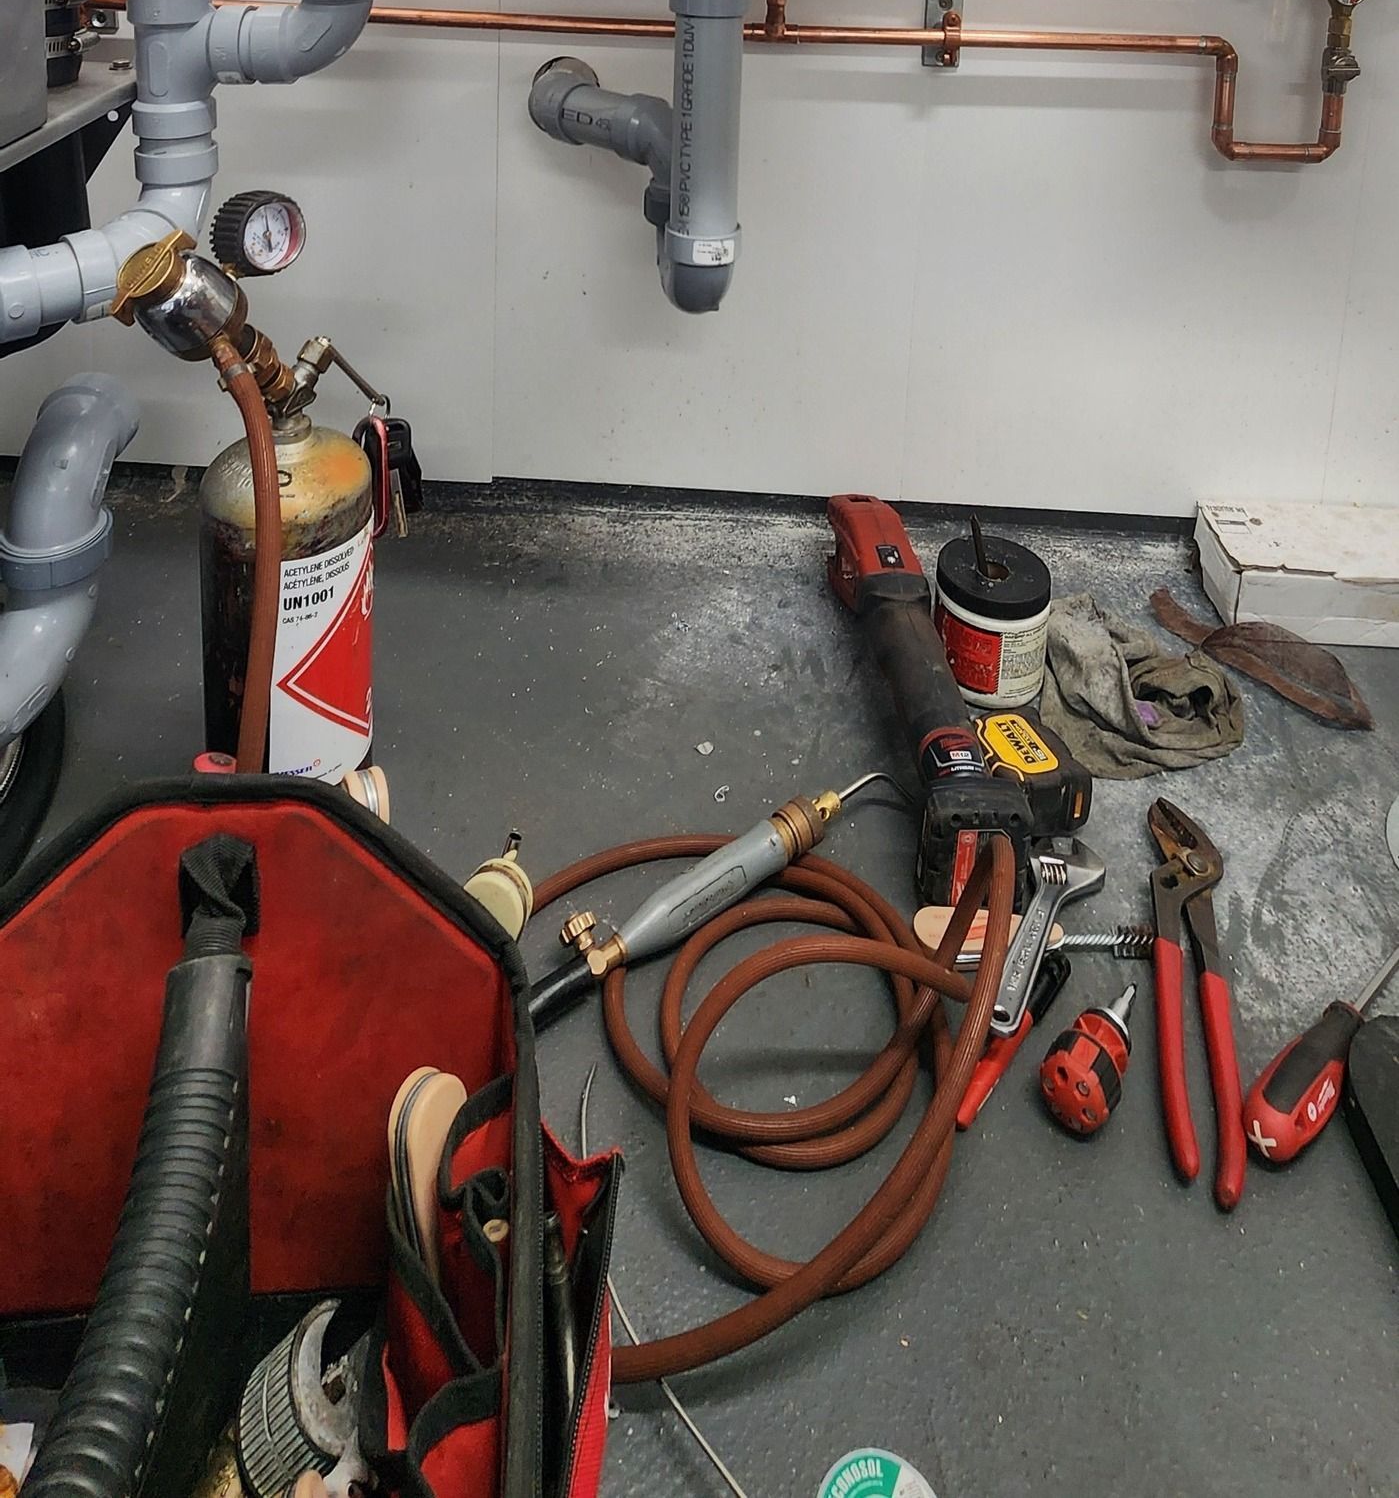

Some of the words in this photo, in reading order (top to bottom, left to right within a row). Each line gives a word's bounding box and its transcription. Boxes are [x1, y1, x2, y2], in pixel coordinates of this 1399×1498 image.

[682, 62, 693, 111] GRADE
[680, 121, 692, 158] TYPE
[284, 562, 323, 578] ACETYLENE
[324, 546, 355, 569] DISSOLVED
[325, 561, 351, 580] DISSOUS
[283, 585, 334, 611] UN1001
[282, 616, 295, 624] CAS
[995, 721, 1038, 764] DEWALT
[828, 1458, 884, 1498] CONOSOL
